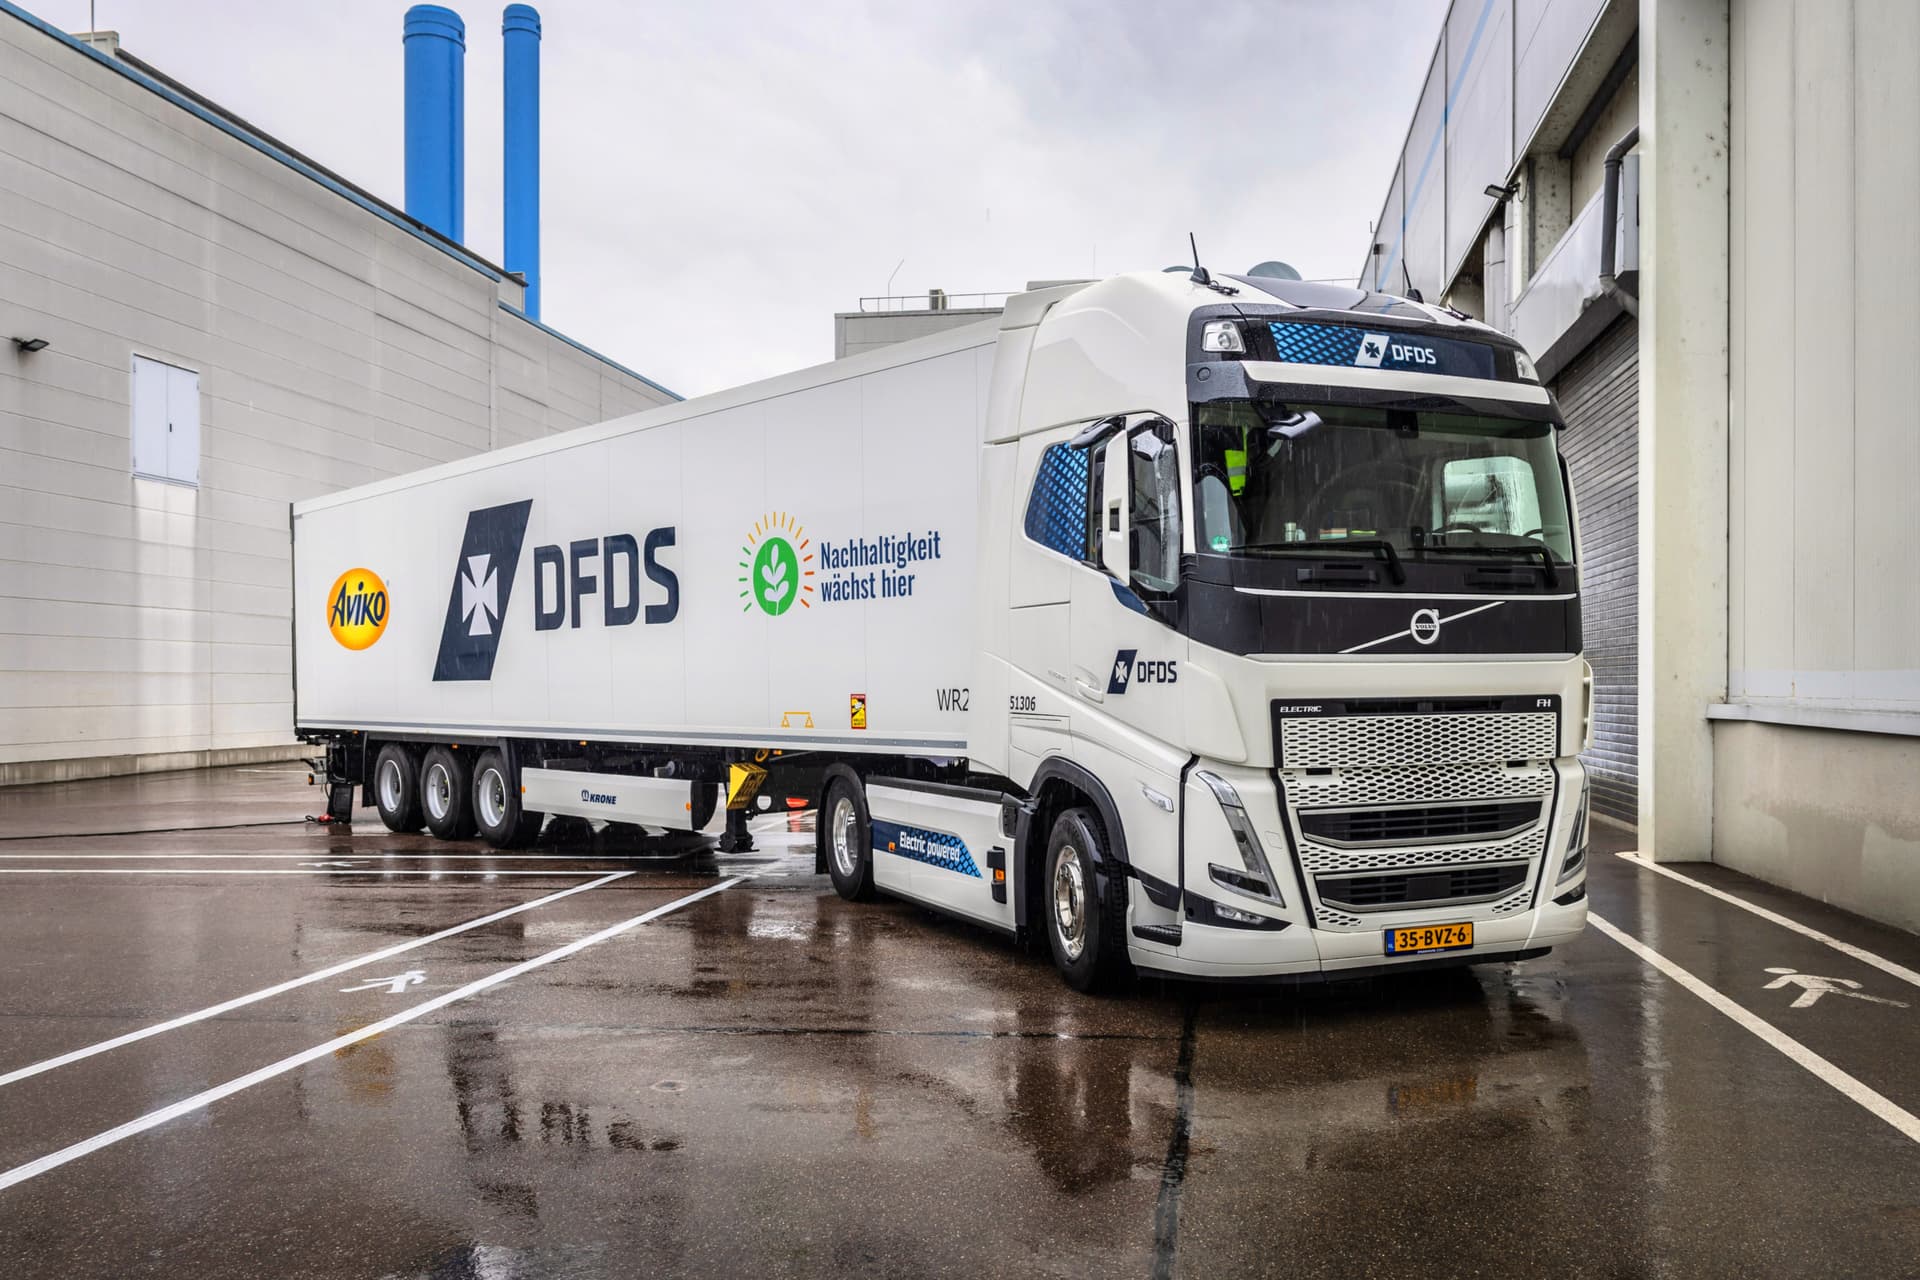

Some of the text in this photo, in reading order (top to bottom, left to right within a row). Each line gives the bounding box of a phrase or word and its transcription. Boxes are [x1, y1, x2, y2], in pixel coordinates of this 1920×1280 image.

[1391, 344, 1437, 365] DFDS
[821, 530, 941, 570] Nachhaltigkeit
[534, 526, 680, 631] DFDS
[821, 568, 915, 602] wächst hier
[1137, 661, 1177, 683] DFDS
[1009, 695, 1036, 711] 51306
[1280, 705, 1322, 713] ELECTRIC
[1536, 698, 1552, 708] FH
[590, 793, 617, 805] KRONE
[899, 831, 961, 861] Electric powered
[1399, 927, 1466, 948] 35-BVZ-6
